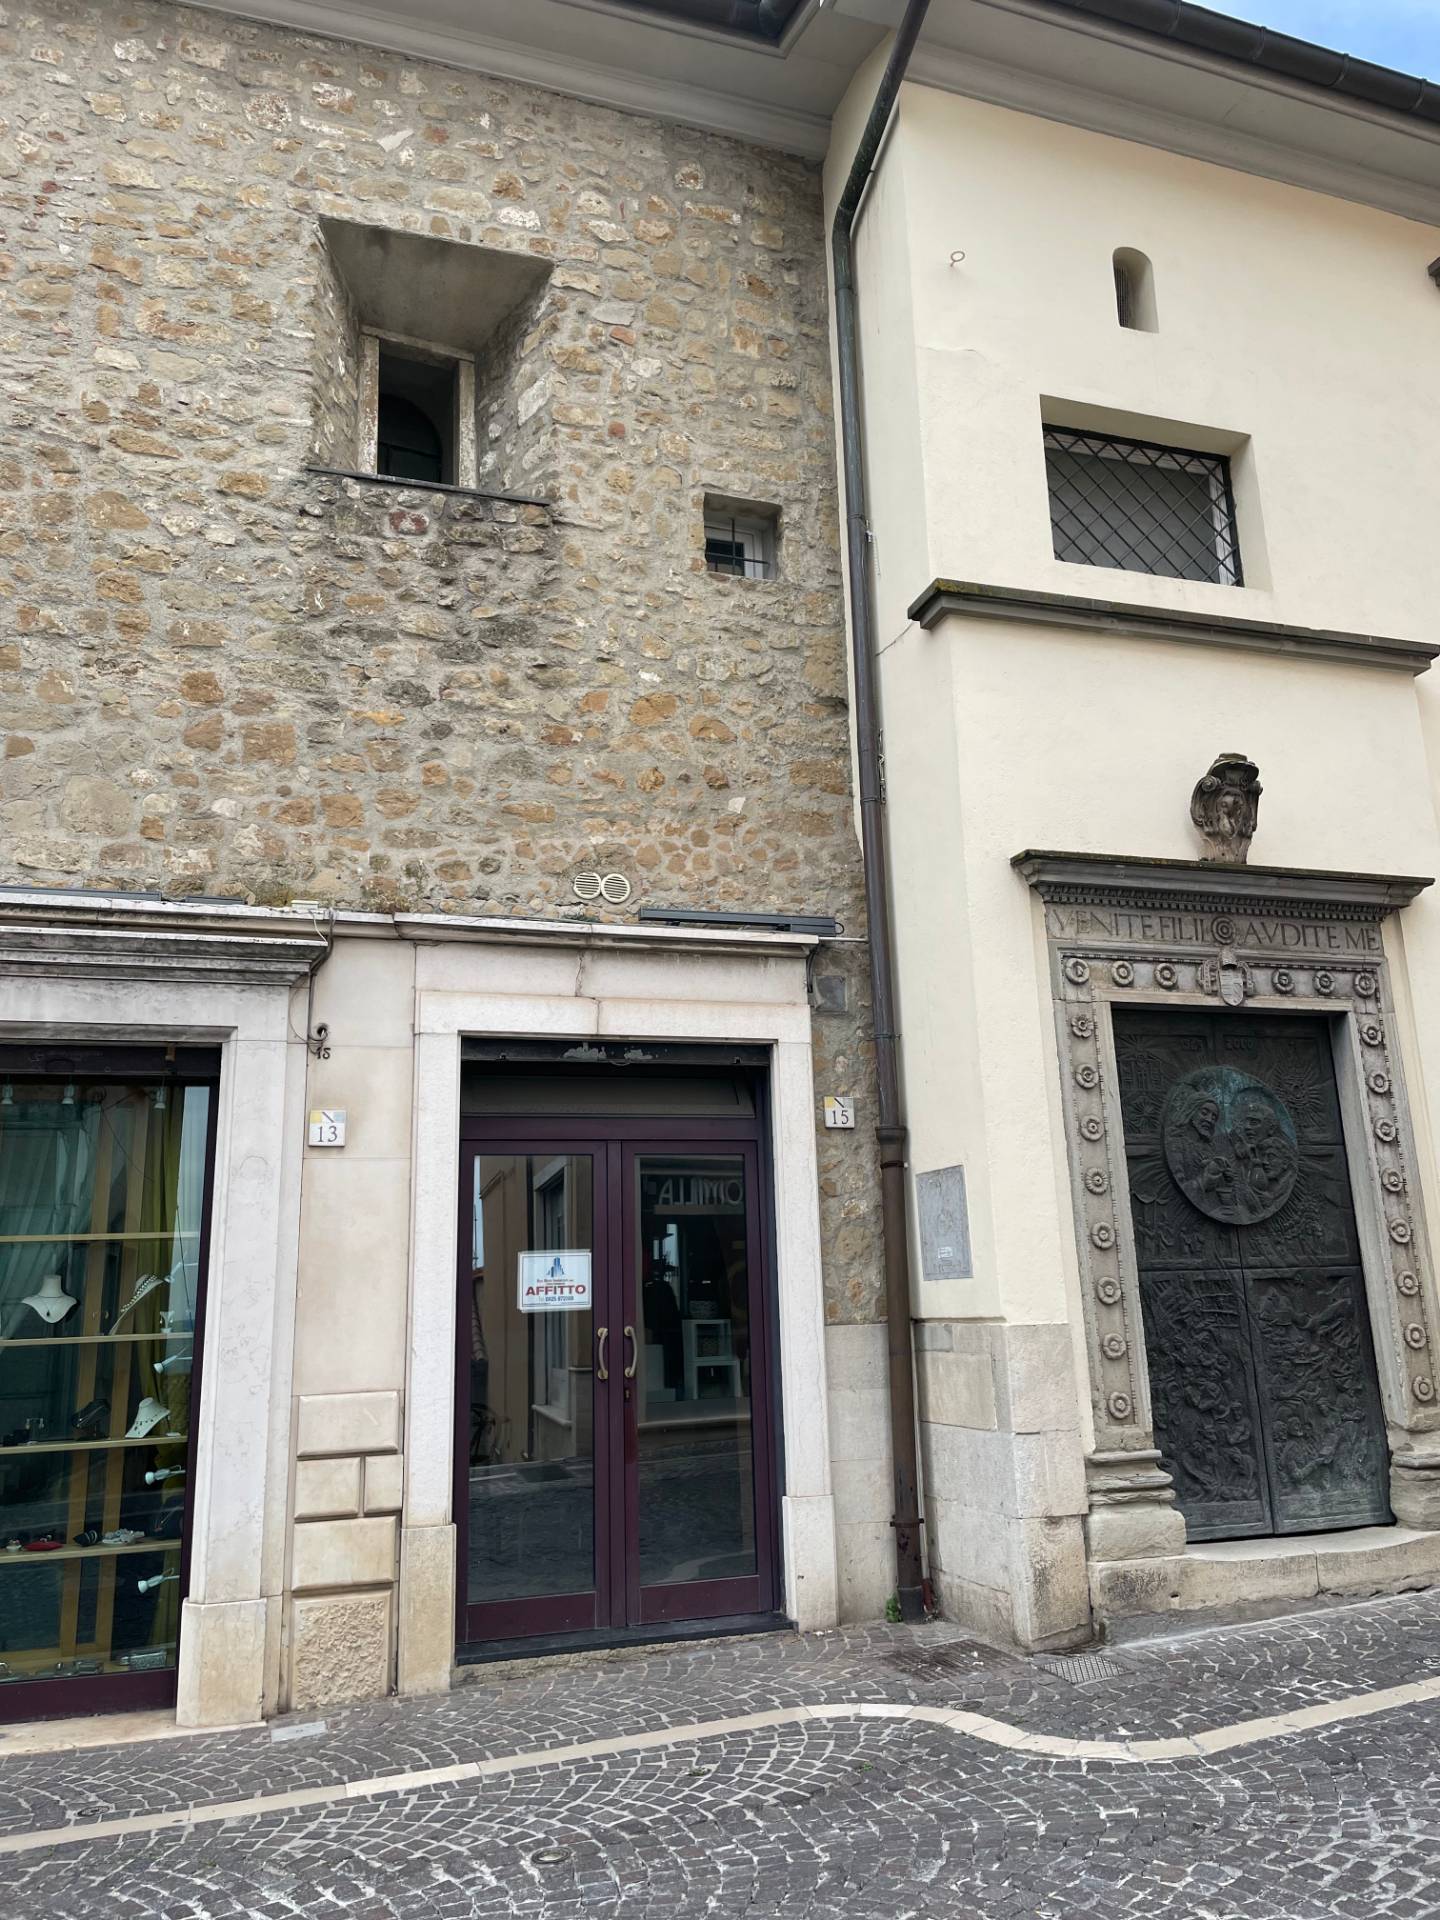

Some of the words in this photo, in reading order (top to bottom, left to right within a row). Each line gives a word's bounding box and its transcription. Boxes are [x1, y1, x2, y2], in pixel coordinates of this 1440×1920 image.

[1050, 909, 1156, 940] VENITE
[1243, 921, 1340, 949] AVDITE
[1344, 926, 1381, 951] ME
[832, 1109, 849, 1125] 15
[317, 1125, 338, 1143] 13
[525, 1284, 586, 1296] AFFITTO
